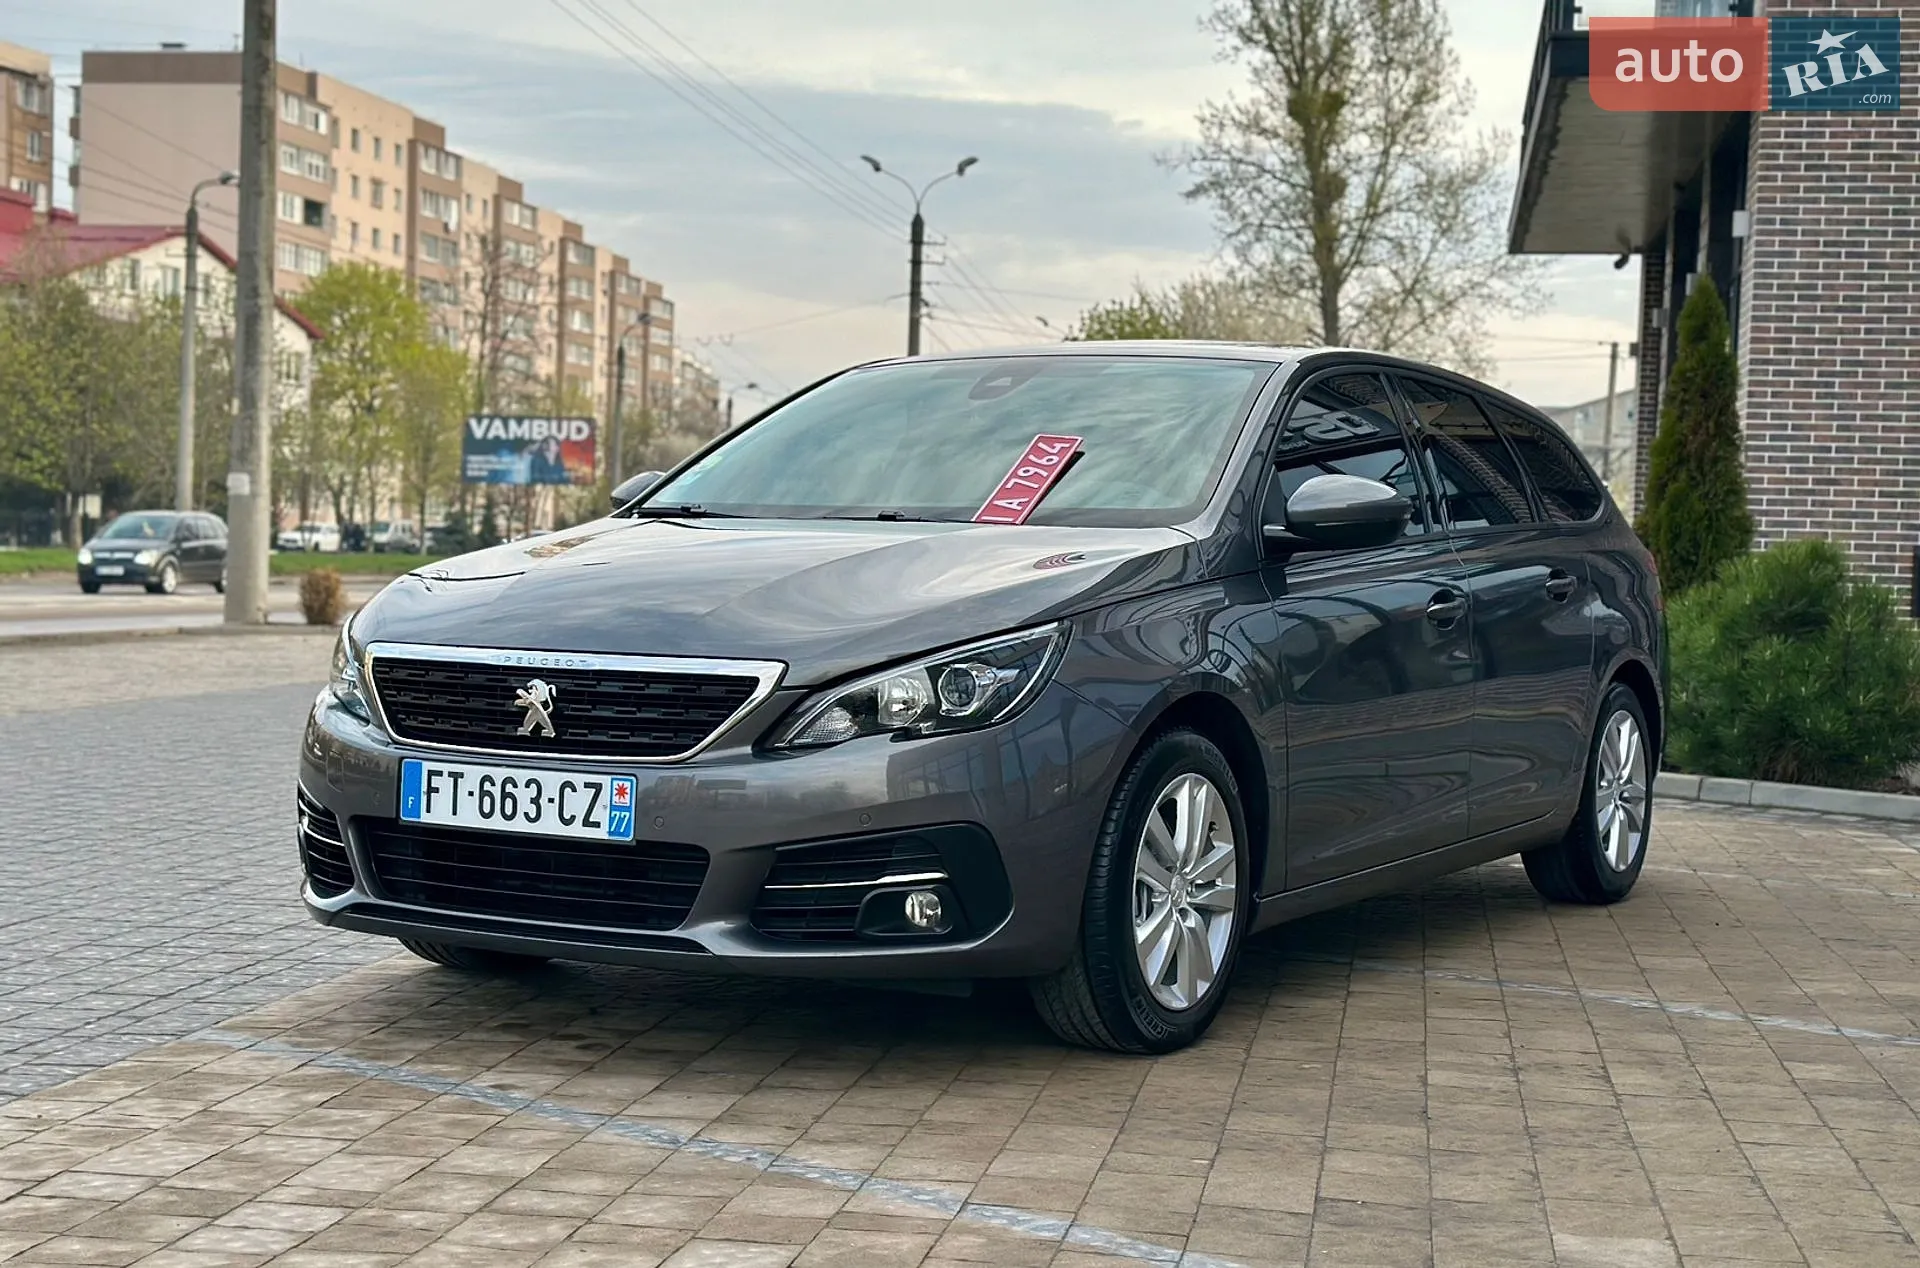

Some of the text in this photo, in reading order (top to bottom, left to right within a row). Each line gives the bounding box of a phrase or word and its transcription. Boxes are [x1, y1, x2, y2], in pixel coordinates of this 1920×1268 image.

[468, 418, 590, 441] VAMBUD
[503, 656, 588, 667] PEUGEOT
[408, 769, 604, 829] F FT-663-CZ
[610, 811, 630, 833] 77
